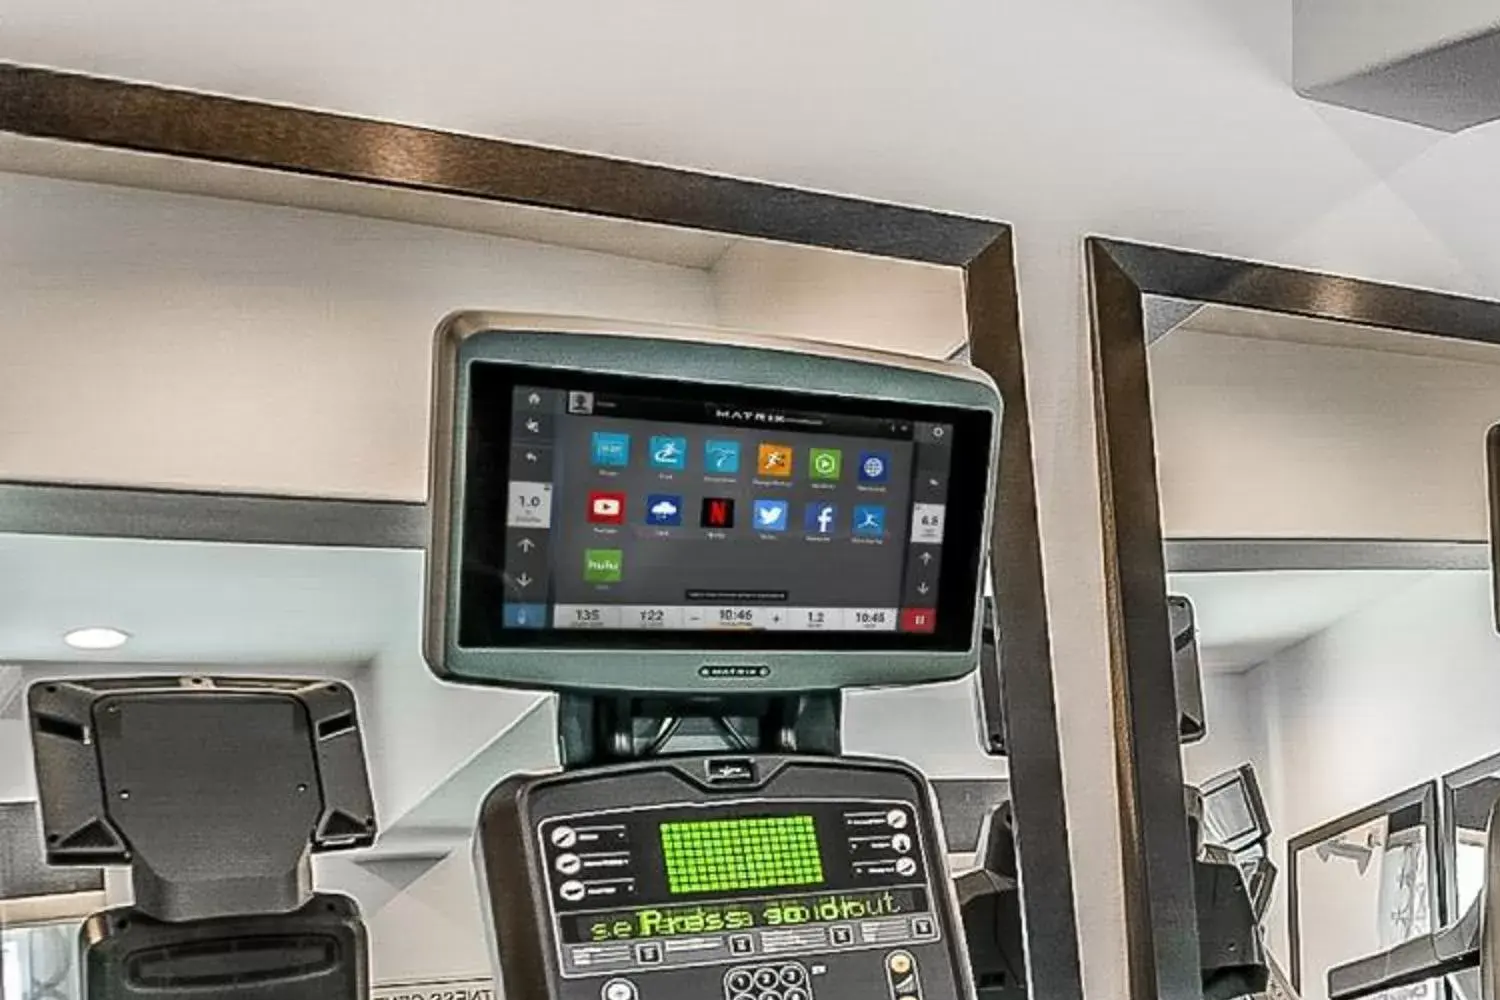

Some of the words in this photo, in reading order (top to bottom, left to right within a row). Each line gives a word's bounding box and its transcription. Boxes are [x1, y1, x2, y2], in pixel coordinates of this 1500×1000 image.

[716, 409, 785, 422] MATRIX
[519, 495, 541, 508] 1.0
[588, 558, 619, 571] hulu
[575, 609, 600, 621] 135
[640, 611, 664, 622] 122
